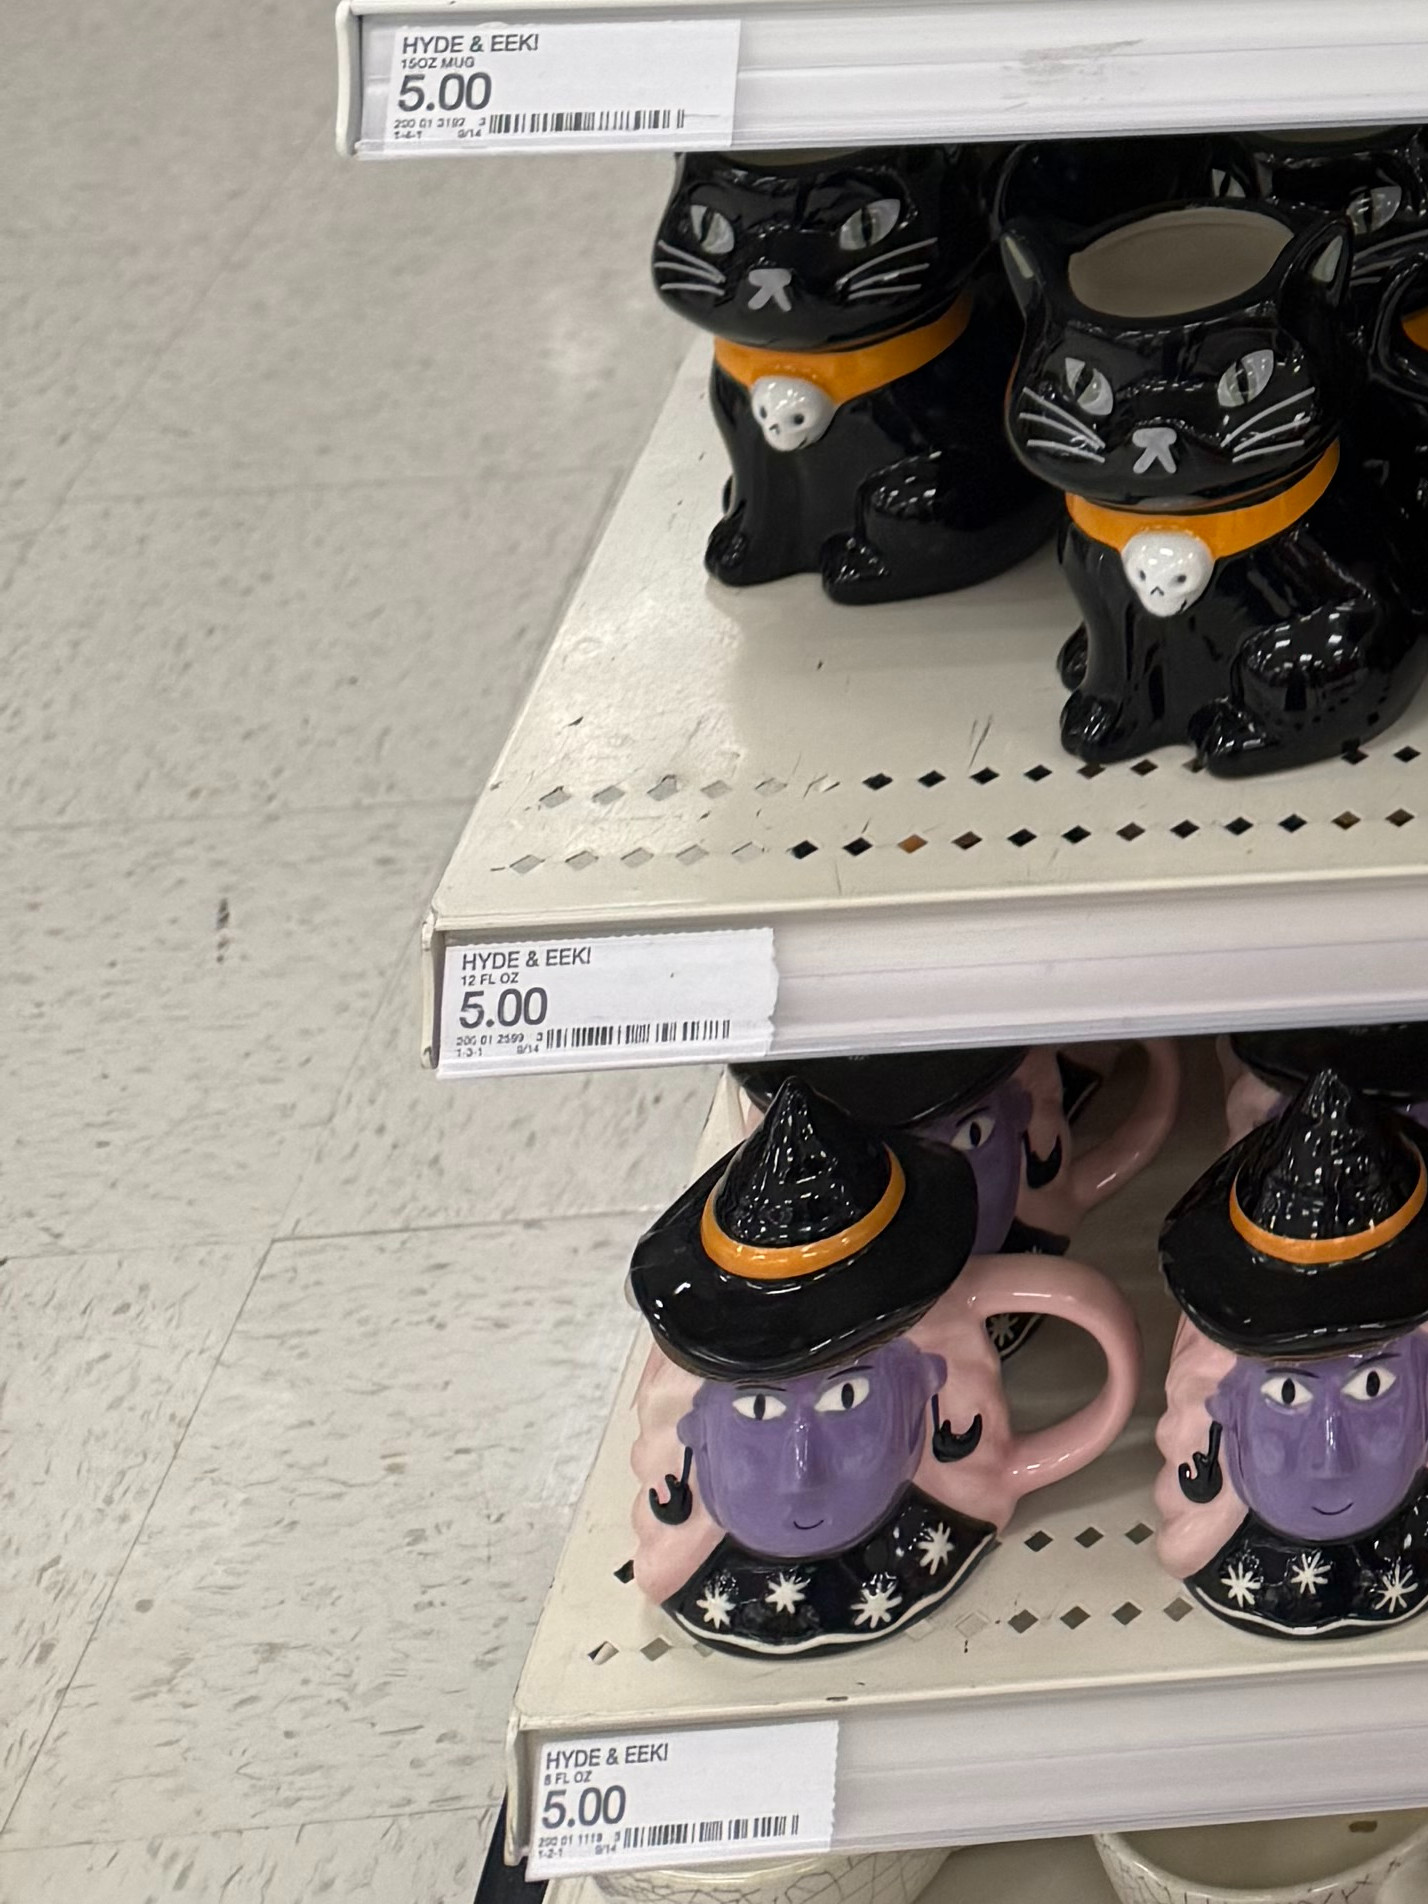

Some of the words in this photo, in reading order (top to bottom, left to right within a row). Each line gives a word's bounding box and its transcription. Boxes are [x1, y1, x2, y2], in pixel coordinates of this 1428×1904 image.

[402, 36, 464, 54] HYDE
[471, 35, 484, 52] &
[441, 56, 475, 68] MUG
[398, 73, 492, 111] 5.00
[462, 951, 520, 971] HYDE
[526, 951, 540, 967] &
[460, 975, 476, 986] 12
[480, 974, 497, 985] FL
[500, 972, 519, 984] OZ
[459, 987, 548, 1029] 5.00
[547, 1748, 601, 1770] HYDE
[606, 1748, 619, 1766] &
[555, 1773, 570, 1784] FL
[574, 1771, 593, 1783] OZ
[542, 1785, 626, 1829] 5.00
